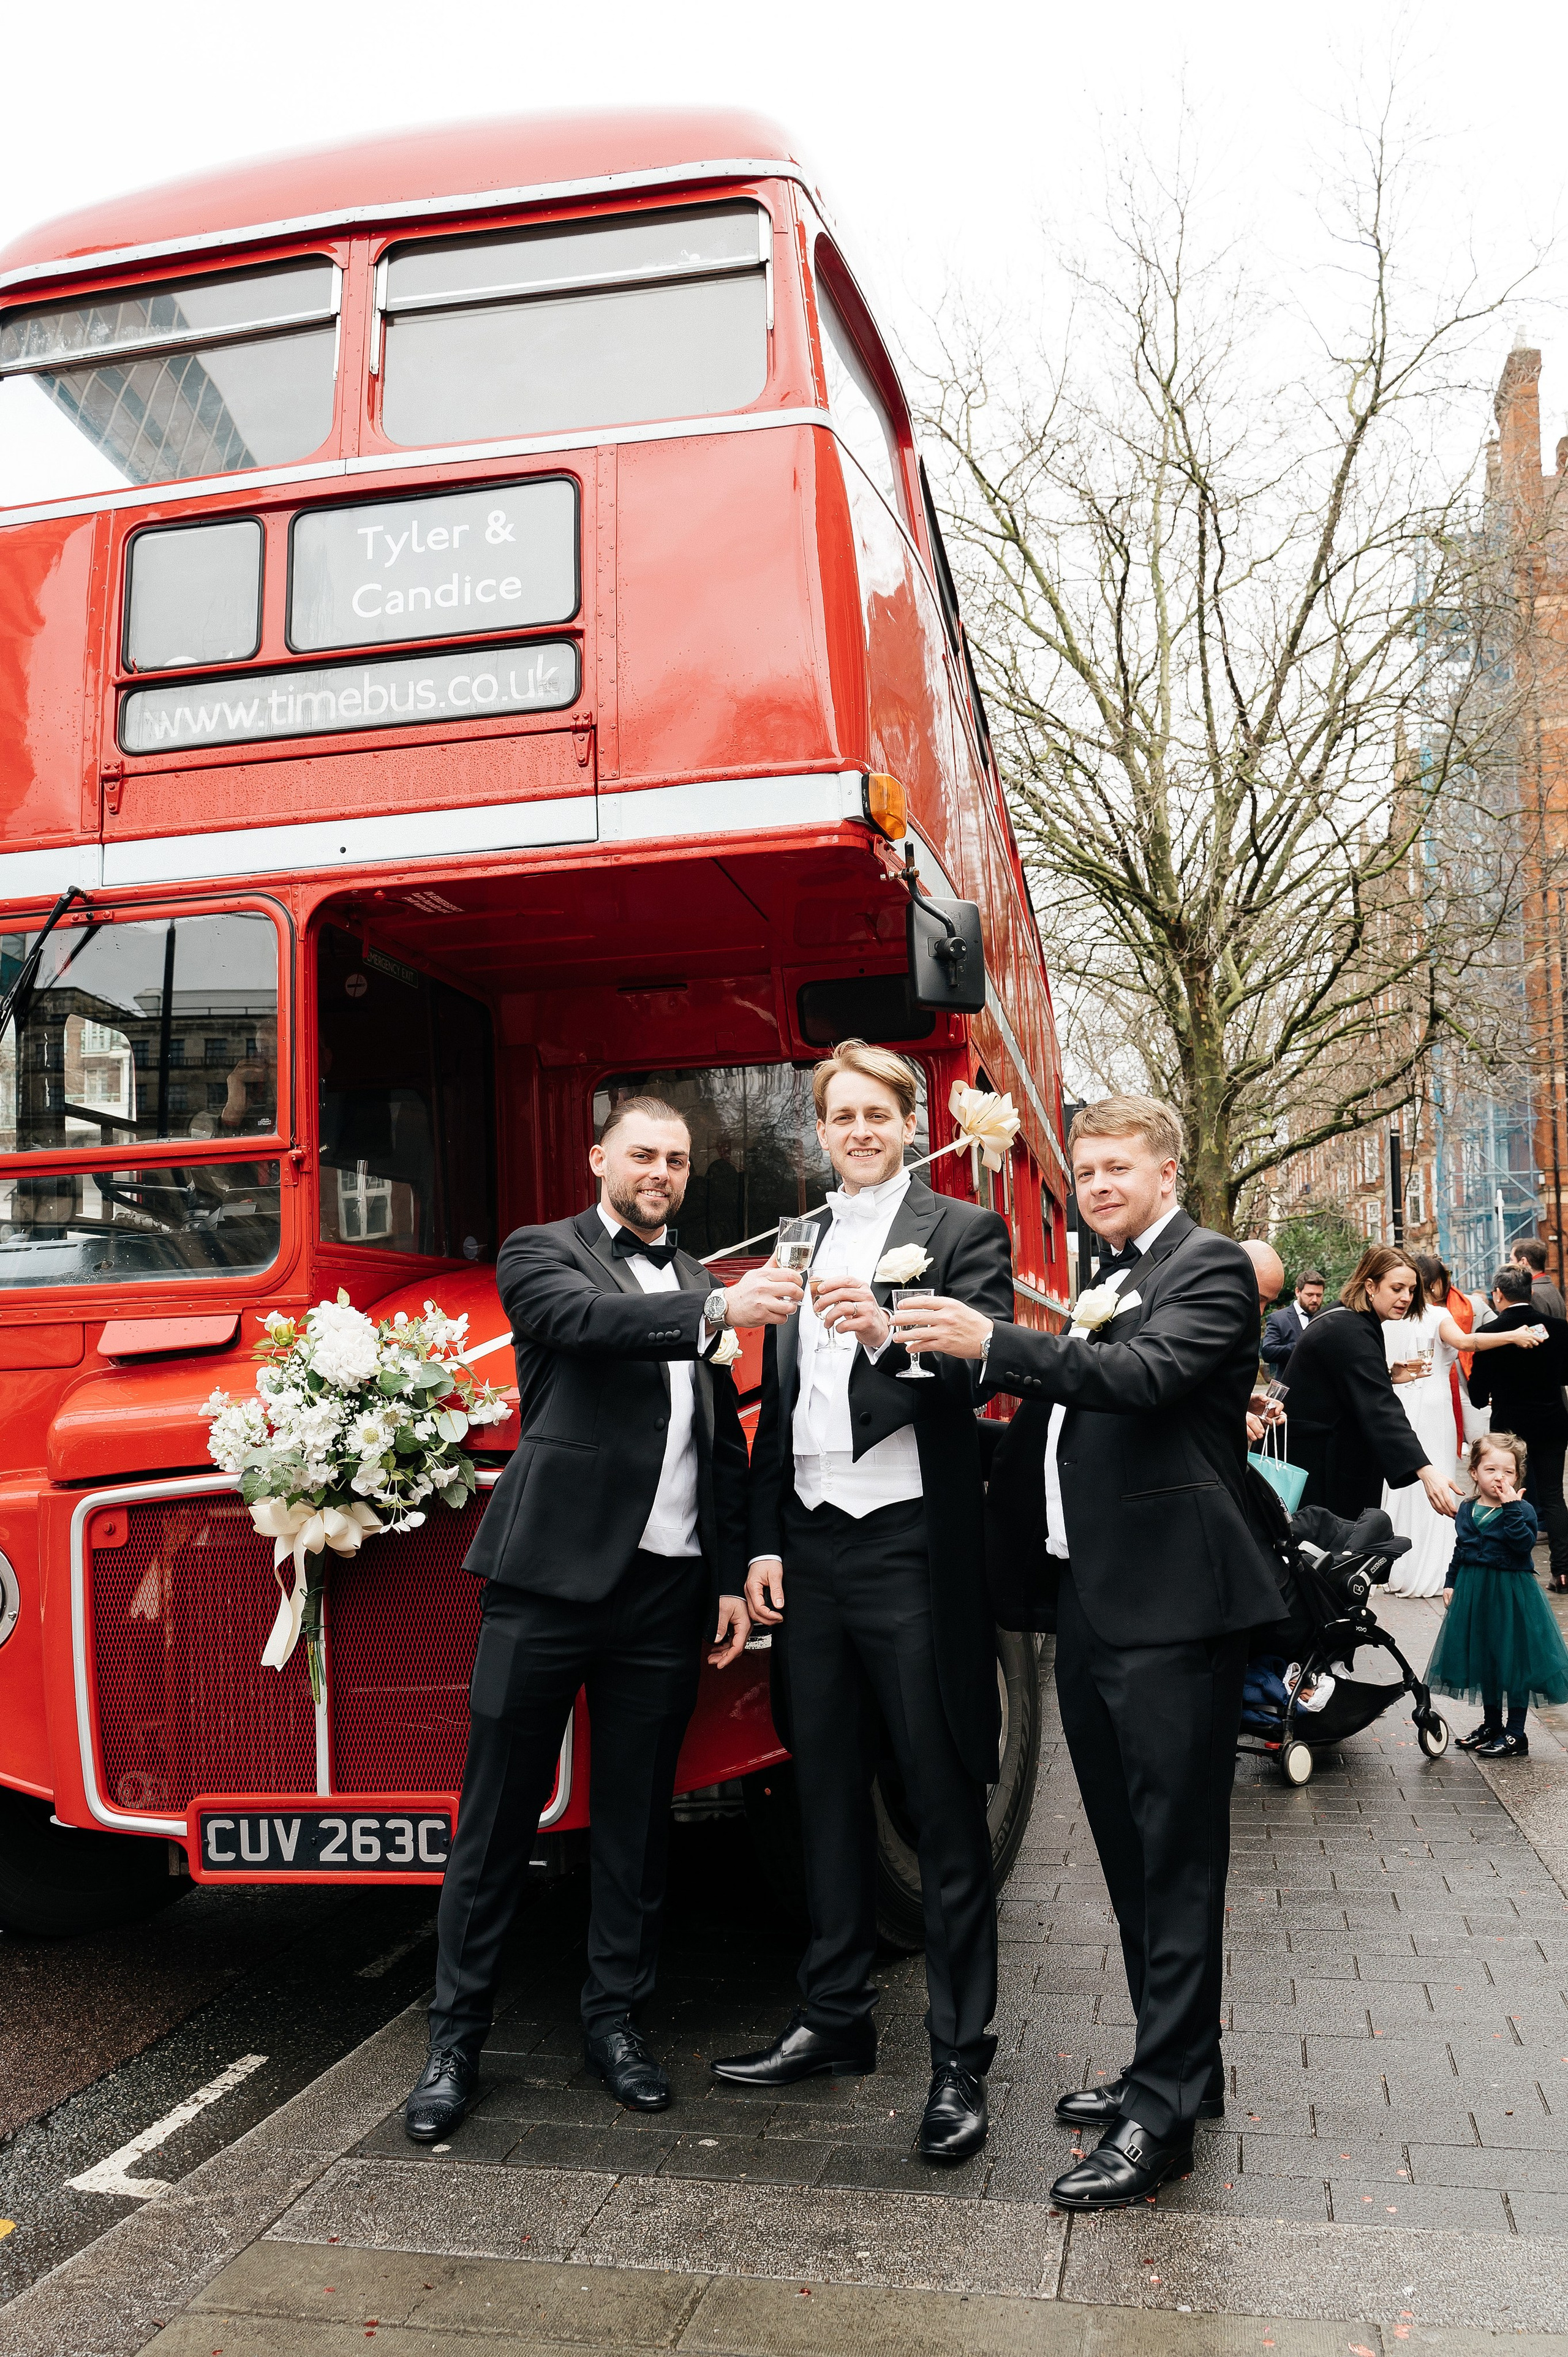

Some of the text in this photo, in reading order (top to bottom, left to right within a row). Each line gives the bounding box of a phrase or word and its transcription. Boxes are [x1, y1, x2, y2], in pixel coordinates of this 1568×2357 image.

[357, 510, 516, 567] Tyler &
[351, 572, 522, 618] Candice
[145, 654, 560, 740] www.timebus.co.uk
[368, 951, 414, 982] EMERGENCY EXIT
[206, 1819, 447, 1863] CUV 263C
